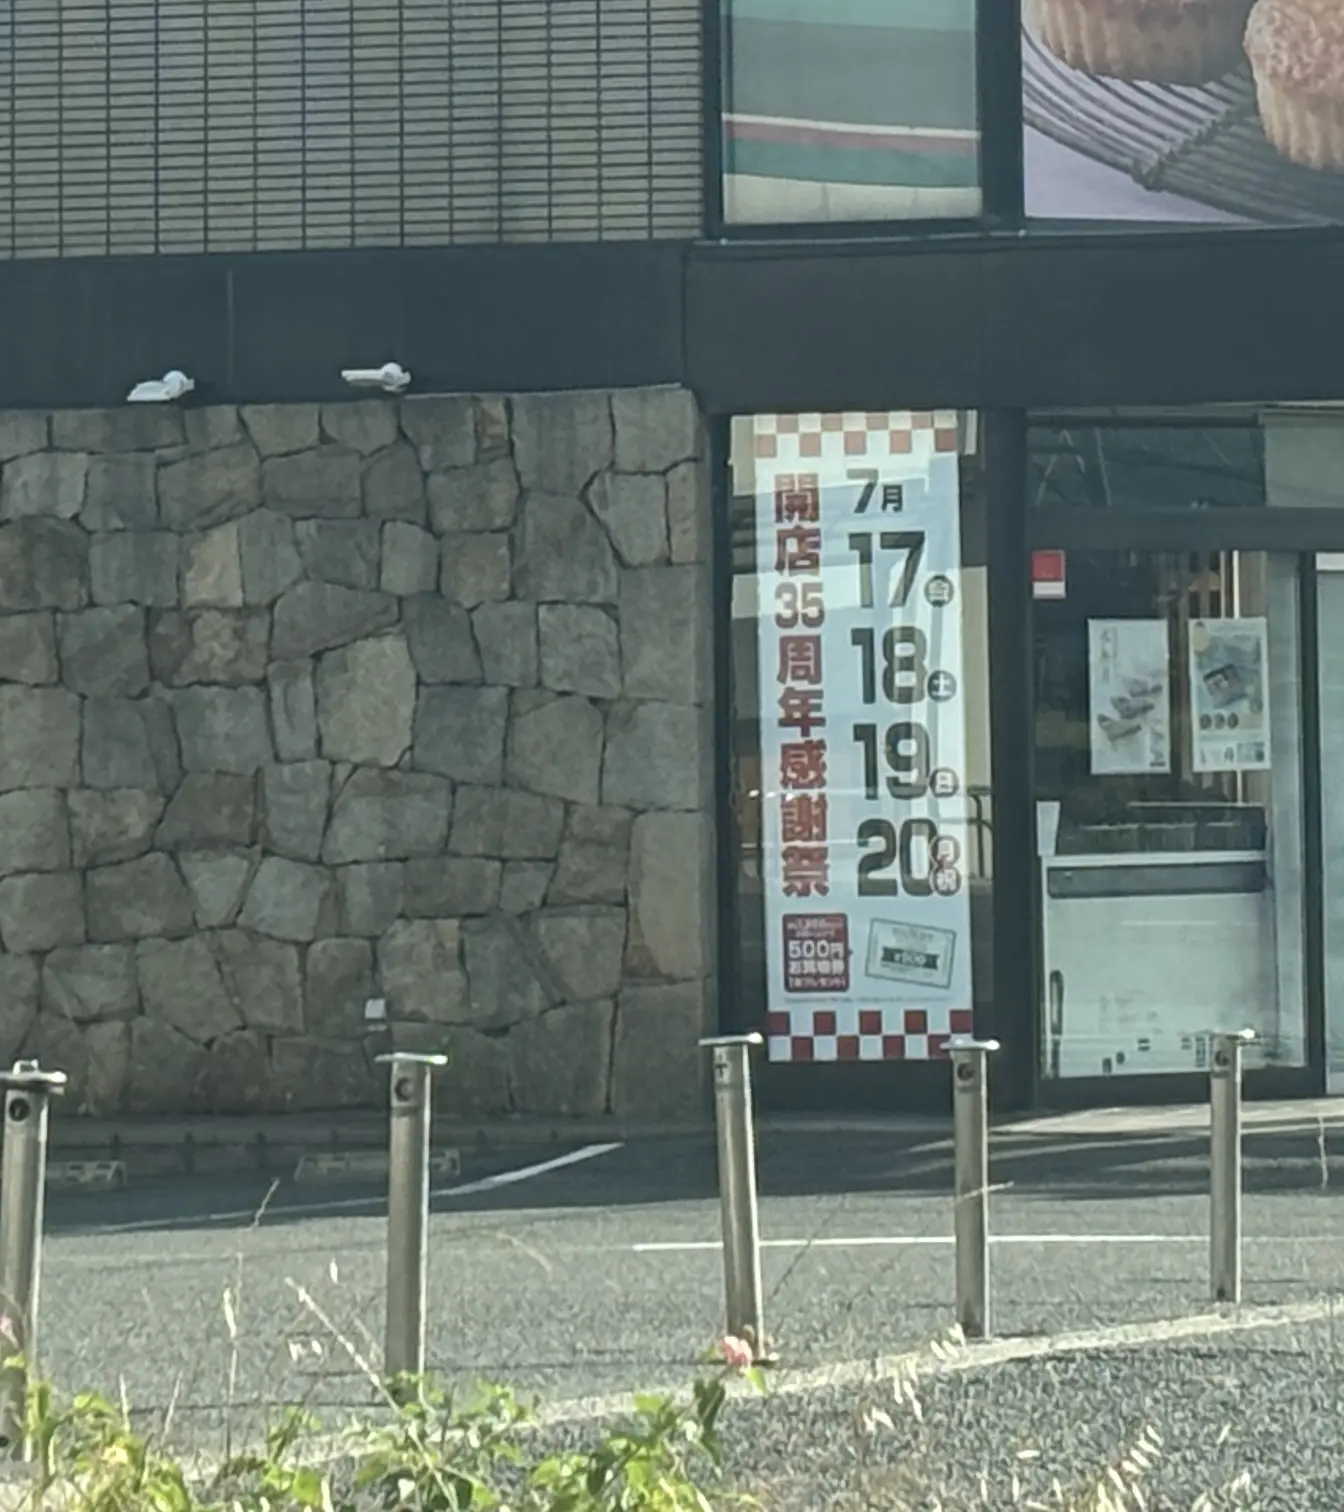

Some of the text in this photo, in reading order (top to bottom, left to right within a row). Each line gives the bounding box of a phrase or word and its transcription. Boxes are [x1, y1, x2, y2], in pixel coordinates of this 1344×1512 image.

[846, 468, 904, 514] 7月
[848, 530, 926, 609] 17
[773, 473, 829, 898] 開店35周年感謝祭
[850, 625, 928, 705] 18
[853, 721, 930, 800] 19
[856, 818, 939, 897] 20
